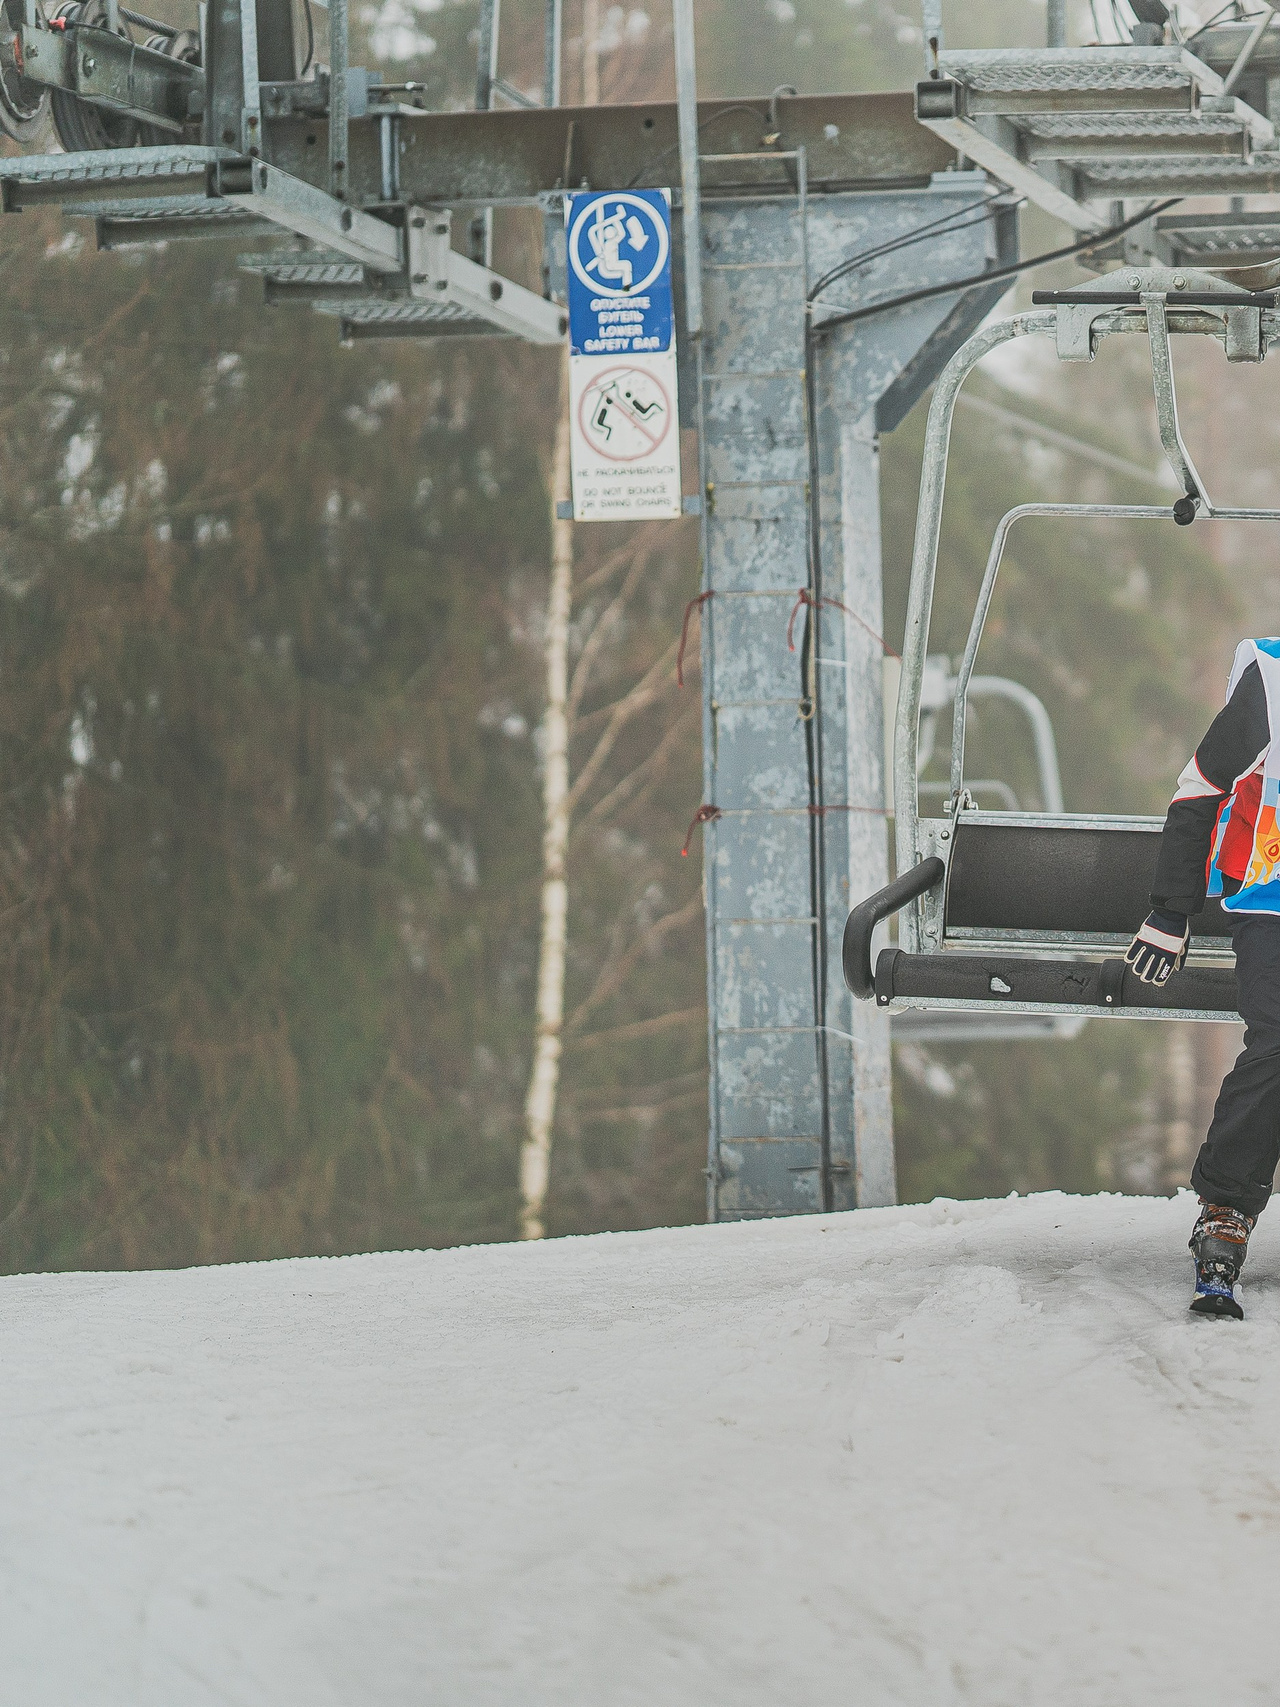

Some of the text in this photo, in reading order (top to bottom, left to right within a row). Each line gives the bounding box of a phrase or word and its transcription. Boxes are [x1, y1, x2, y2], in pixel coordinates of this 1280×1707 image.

[599, 324, 643, 338] LOWER
[584, 336, 660, 352] SAFETY BAR
[584, 485, 667, 497] DO NOT BOUNCE
[582, 499, 595, 508] OR
[601, 498, 630, 507] SWING
